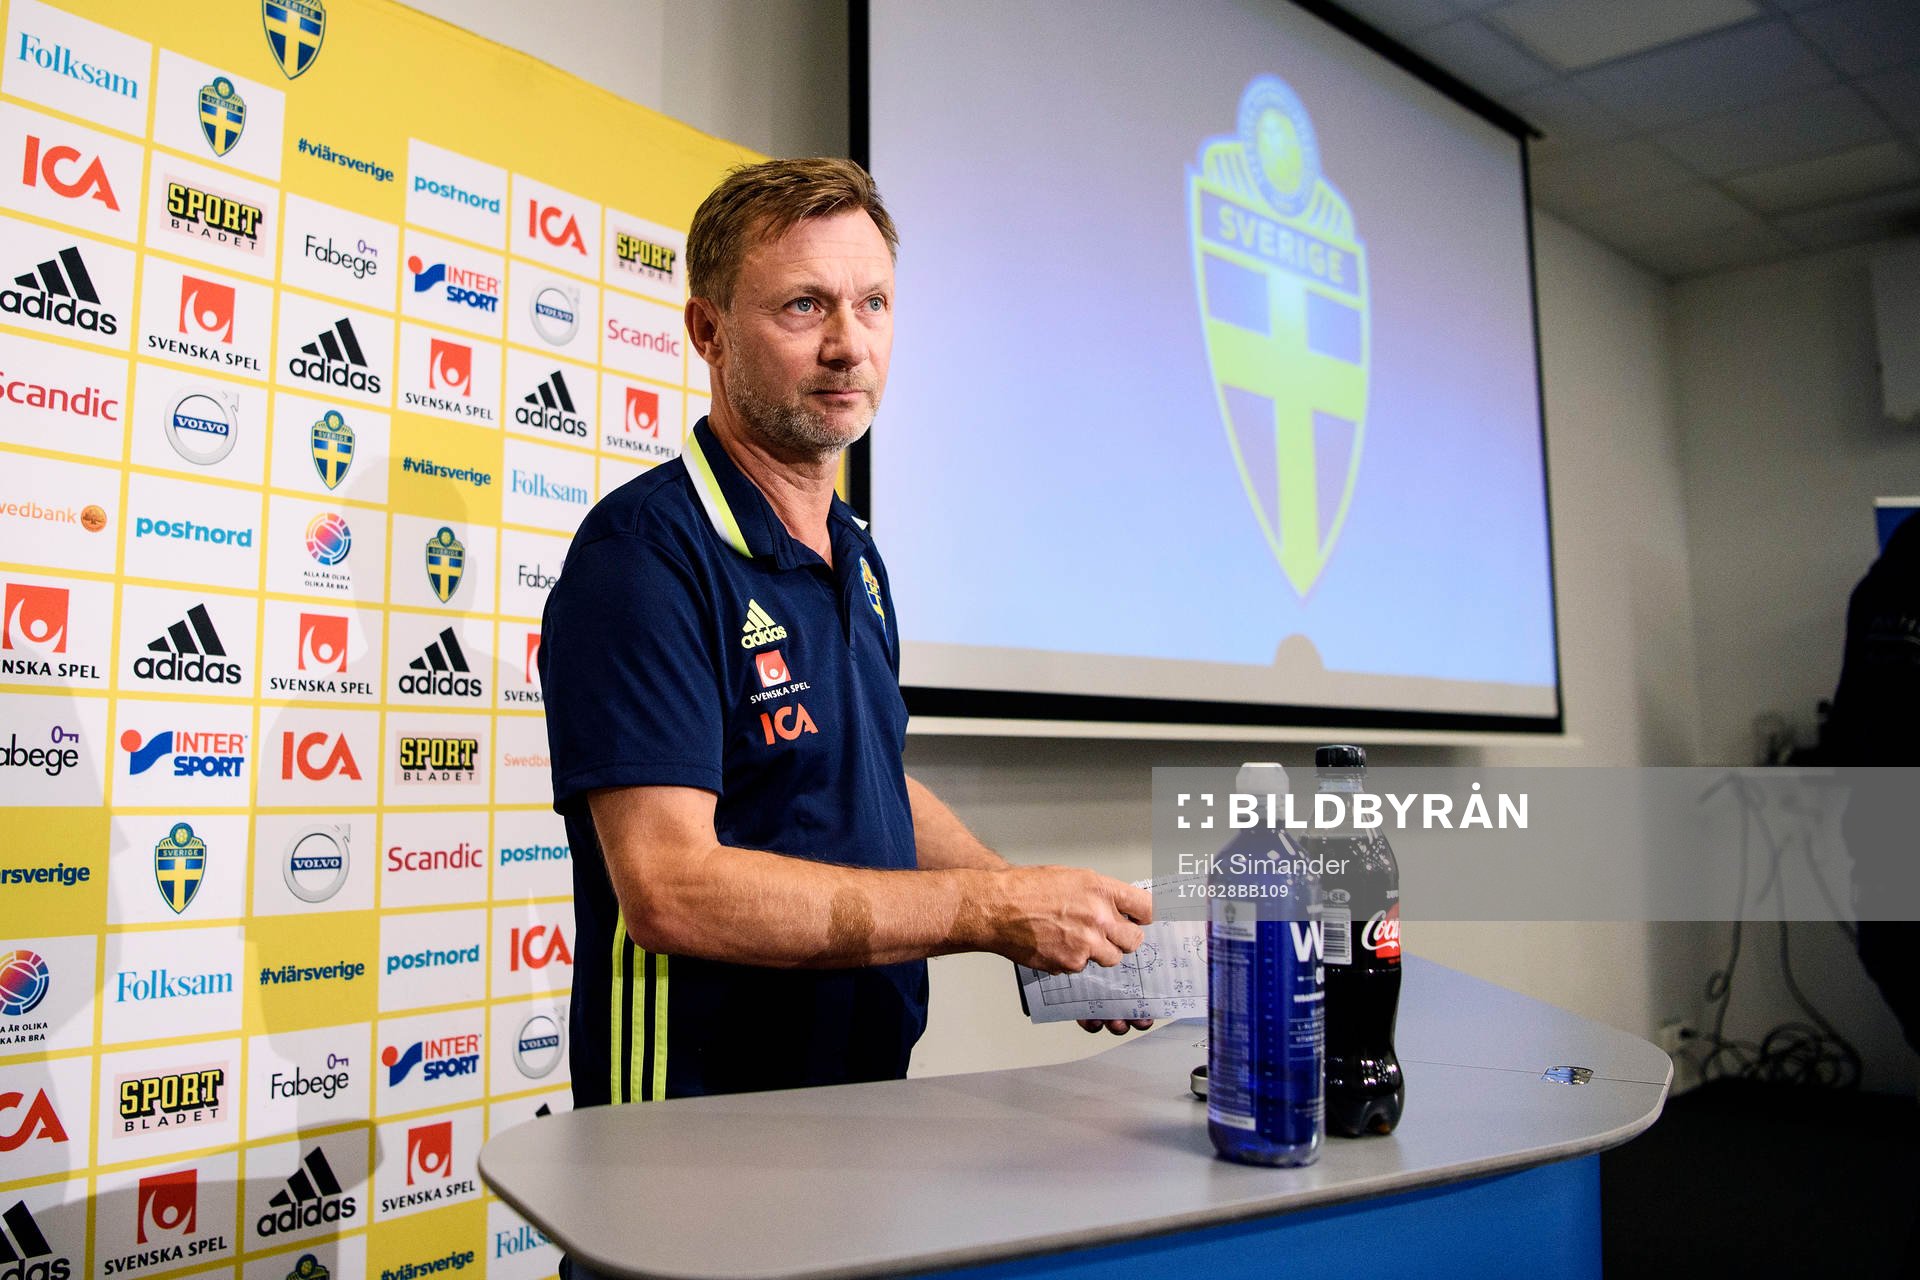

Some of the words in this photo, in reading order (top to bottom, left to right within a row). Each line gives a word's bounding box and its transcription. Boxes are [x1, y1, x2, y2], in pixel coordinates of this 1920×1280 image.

[16, 32, 138, 99] Folksam
[22, 134, 120, 212] ICA
[298, 138, 394, 182] #viärsverige
[414, 175, 500, 214] postnord
[167, 182, 263, 239] SPORT
[171, 219, 257, 250] BLADET
[529, 199, 588, 256] ICA
[305, 234, 377, 279] Fabege
[616, 232, 676, 275] SPORT
[1218, 204, 1344, 284] SVERIGE
[447, 265, 498, 294] INTER
[0, 287, 118, 336] adidas
[447, 286, 498, 313] SPORT
[537, 304, 573, 323] VOLVO
[148, 334, 220, 364] SVENSKA
[225, 353, 262, 372] SPEL
[607, 319, 680, 357] Scandic
[288, 356, 381, 394] adidas
[0, 371, 118, 422] candic
[405, 392, 461, 414] SVENSKA
[466, 404, 493, 420] SPEL
[176, 415, 228, 435] VOLVO
[515, 404, 587, 438] adidas
[607, 435, 651, 454] SVENSKA
[654, 446, 676, 458] SPEL
[403, 457, 491, 485] #viärsverige
[512, 469, 588, 505] Folksam
[136, 517, 252, 548] postnord
[741, 624, 787, 649] adidas
[2, 659, 52, 676] NSKA
[58, 663, 100, 678] SPEL
[134, 652, 242, 685] adidas
[399, 671, 482, 697] adidas
[270, 677, 335, 693] SVENSKA
[340, 681, 373, 695] SPEL
[504, 690, 544, 702] SVENS
[750, 686, 790, 704] SVENSKA
[790, 681, 811, 693] SPEL
[760, 703, 819, 746] ICA
[176, 731, 243, 754] INTER
[281, 731, 363, 781] ICA
[400, 737, 478, 771] SPORT
[173, 756, 245, 777] SPORT
[403, 771, 475, 781] BLADET
[162, 849, 199, 857] SVERIGE
[293, 858, 340, 870] VOLVO
[388, 843, 483, 872] Scandic
[0, 863, 91, 886] rsverige
[387, 944, 480, 975] postnord
[510, 924, 573, 972] ICA
[115, 968, 233, 1003] Folksam
[260, 960, 365, 986] #viärsverige
[22, 1021, 48, 1031] OLIKA
[28, 1033, 46, 1042] BRA
[425, 1034, 479, 1059] INTER
[519, 1034, 559, 1052] VOLVO
[424, 1054, 480, 1081] SPORT
[120, 1068, 224, 1119] SPORT
[271, 1067, 349, 1100] Fabege
[125, 1108, 219, 1133] BLADET
[382, 1188, 442, 1213] SVENSKA
[446, 1180, 475, 1198] SPEL
[257, 1195, 356, 1238] adidas
[104, 1246, 184, 1276] SVENSKA
[188, 1235, 228, 1256] SPEL
[381, 1249, 475, 1280] #viärsverige
